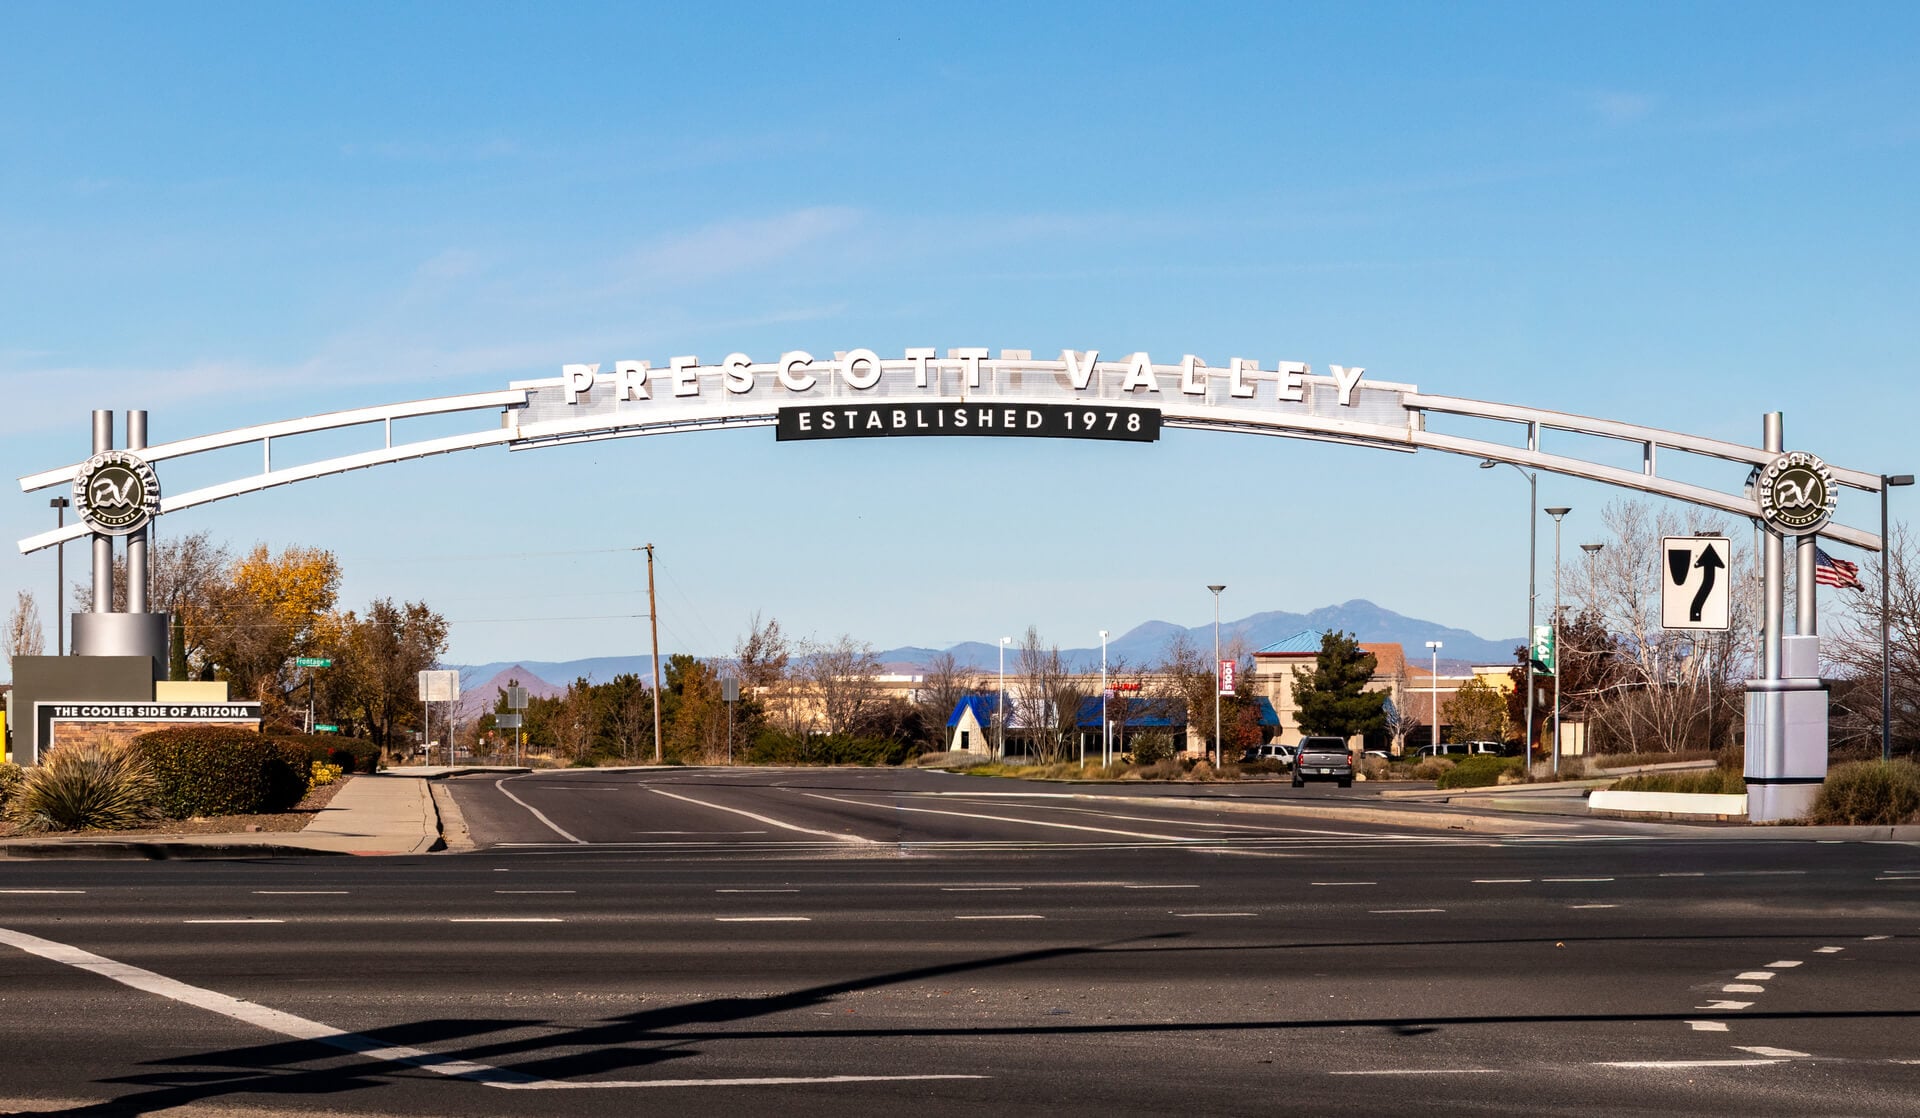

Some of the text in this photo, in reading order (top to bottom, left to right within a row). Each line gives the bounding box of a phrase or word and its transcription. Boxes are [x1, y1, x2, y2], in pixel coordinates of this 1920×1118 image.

[562, 347, 1365, 406] PRESCOTT VALLEY
[799, 408, 1141, 432] ESTABLISHED 1978
[73, 452, 124, 519] PRESCOTT
[1760, 452, 1838, 519] PRESCOTT VALLEY
[95, 512, 136, 524] ARIZONA
[1780, 512, 1818, 524] ARIZONA
[54, 706, 249, 717] THE COOLER SIDE OF ARIZONA
